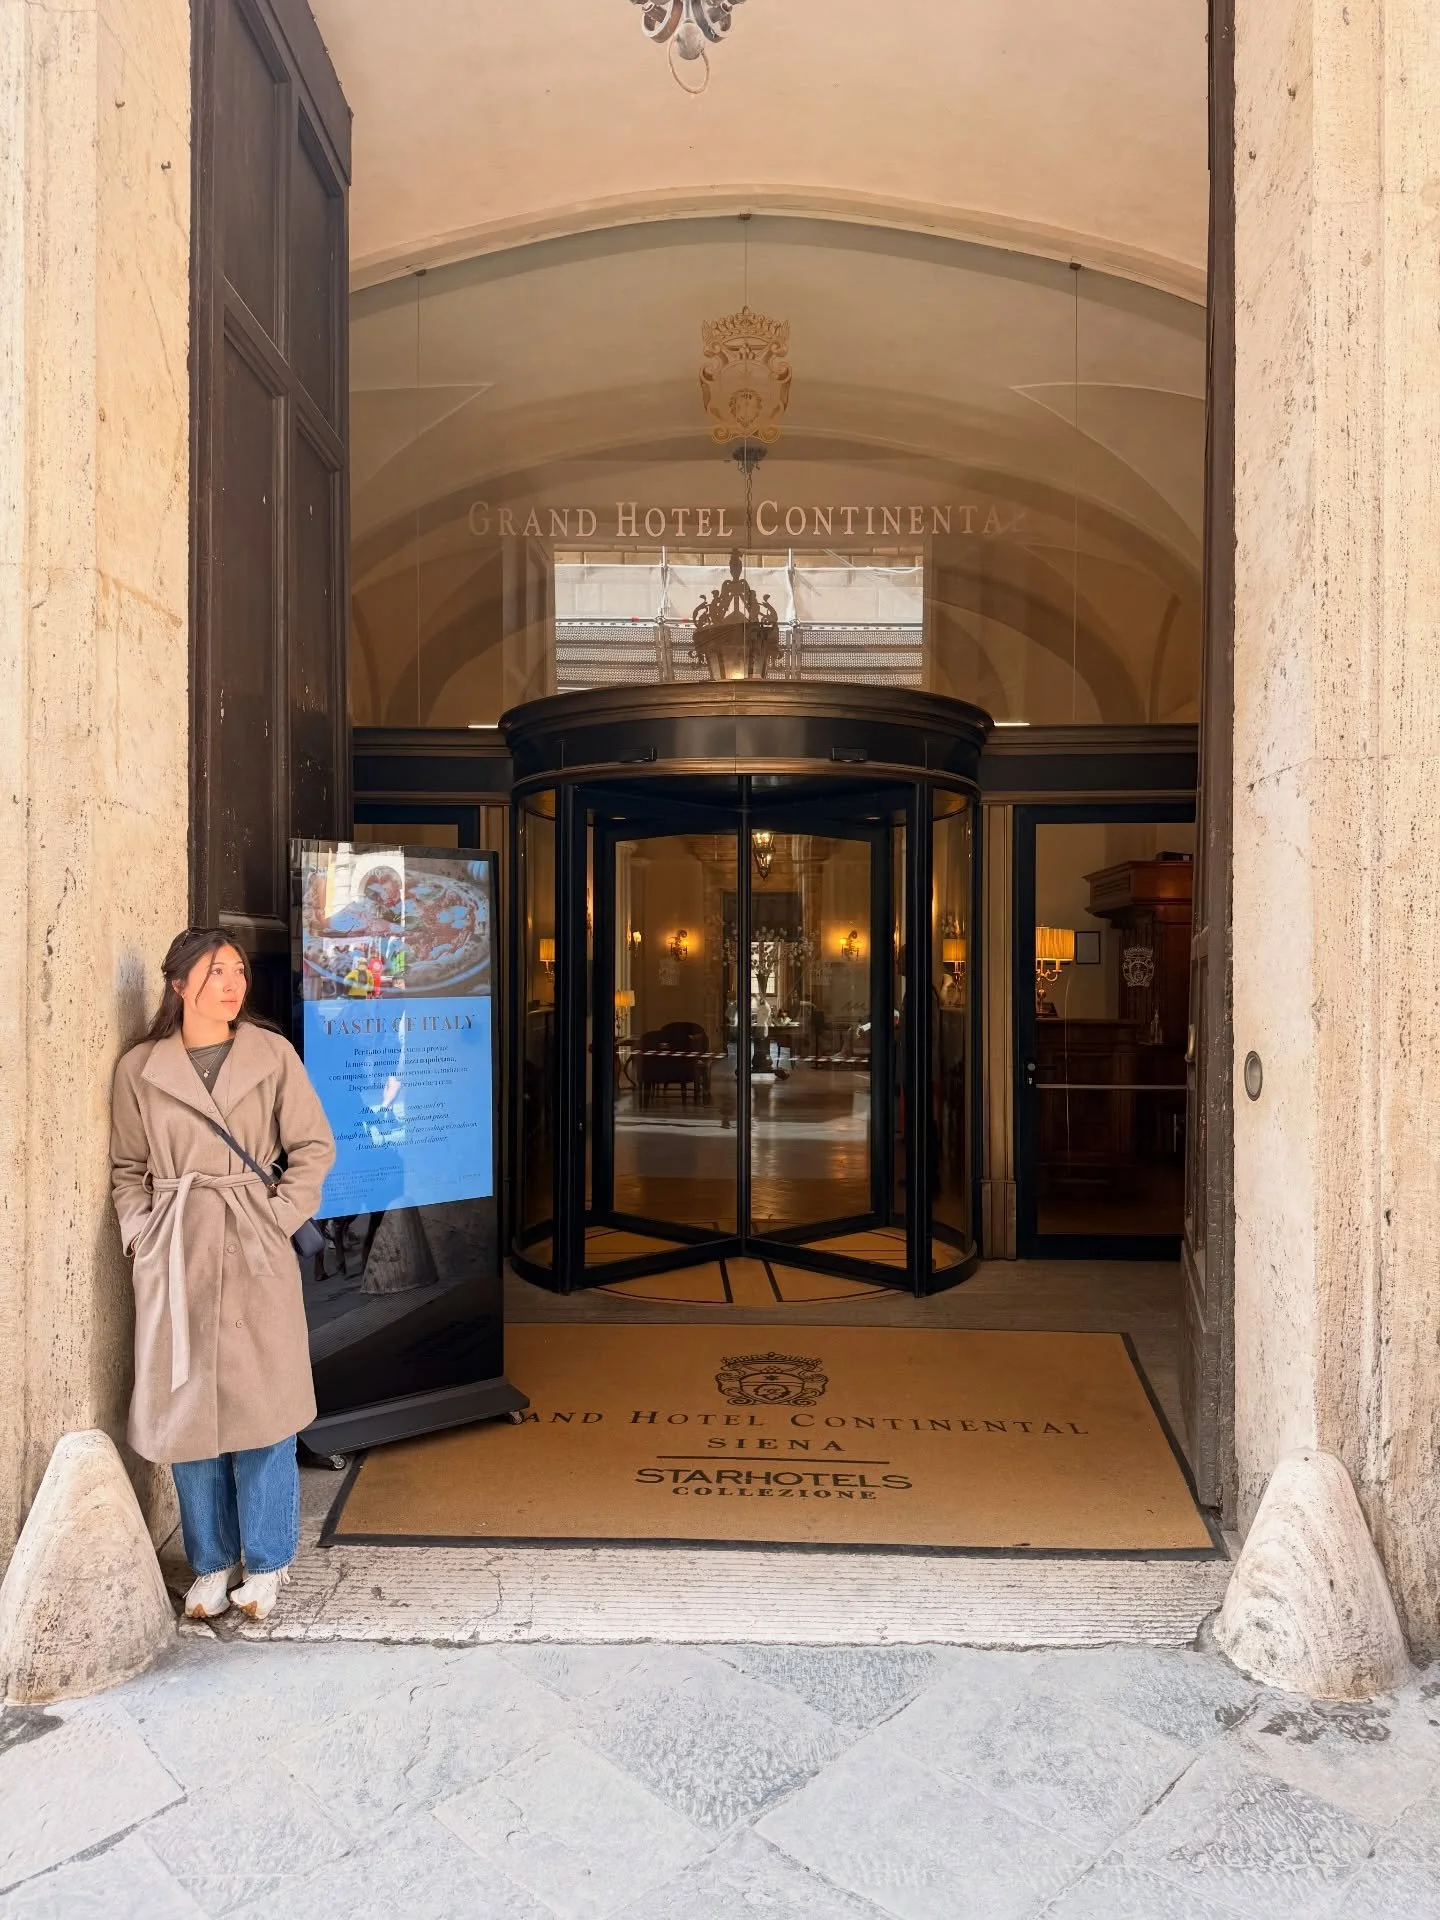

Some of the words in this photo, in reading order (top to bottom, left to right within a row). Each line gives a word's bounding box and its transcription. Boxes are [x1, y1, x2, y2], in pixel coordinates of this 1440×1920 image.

[468, 500, 597, 537] GRAND
[616, 501, 733, 537] HOTEL
[324, 1017, 387, 1035] TASTE
[392, 1016, 417, 1033] OF
[422, 1014, 475, 1031] ITALY
[524, 1411, 604, 1424] AND
[630, 1410, 765, 1426] HOTEL
[790, 1413, 1089, 1435] CONTINENTAL
[708, 1437, 846, 1451] SIENA
[635, 1468, 912, 1489] STARHOTELS
[672, 1486, 876, 1500] COLLEZIONE
